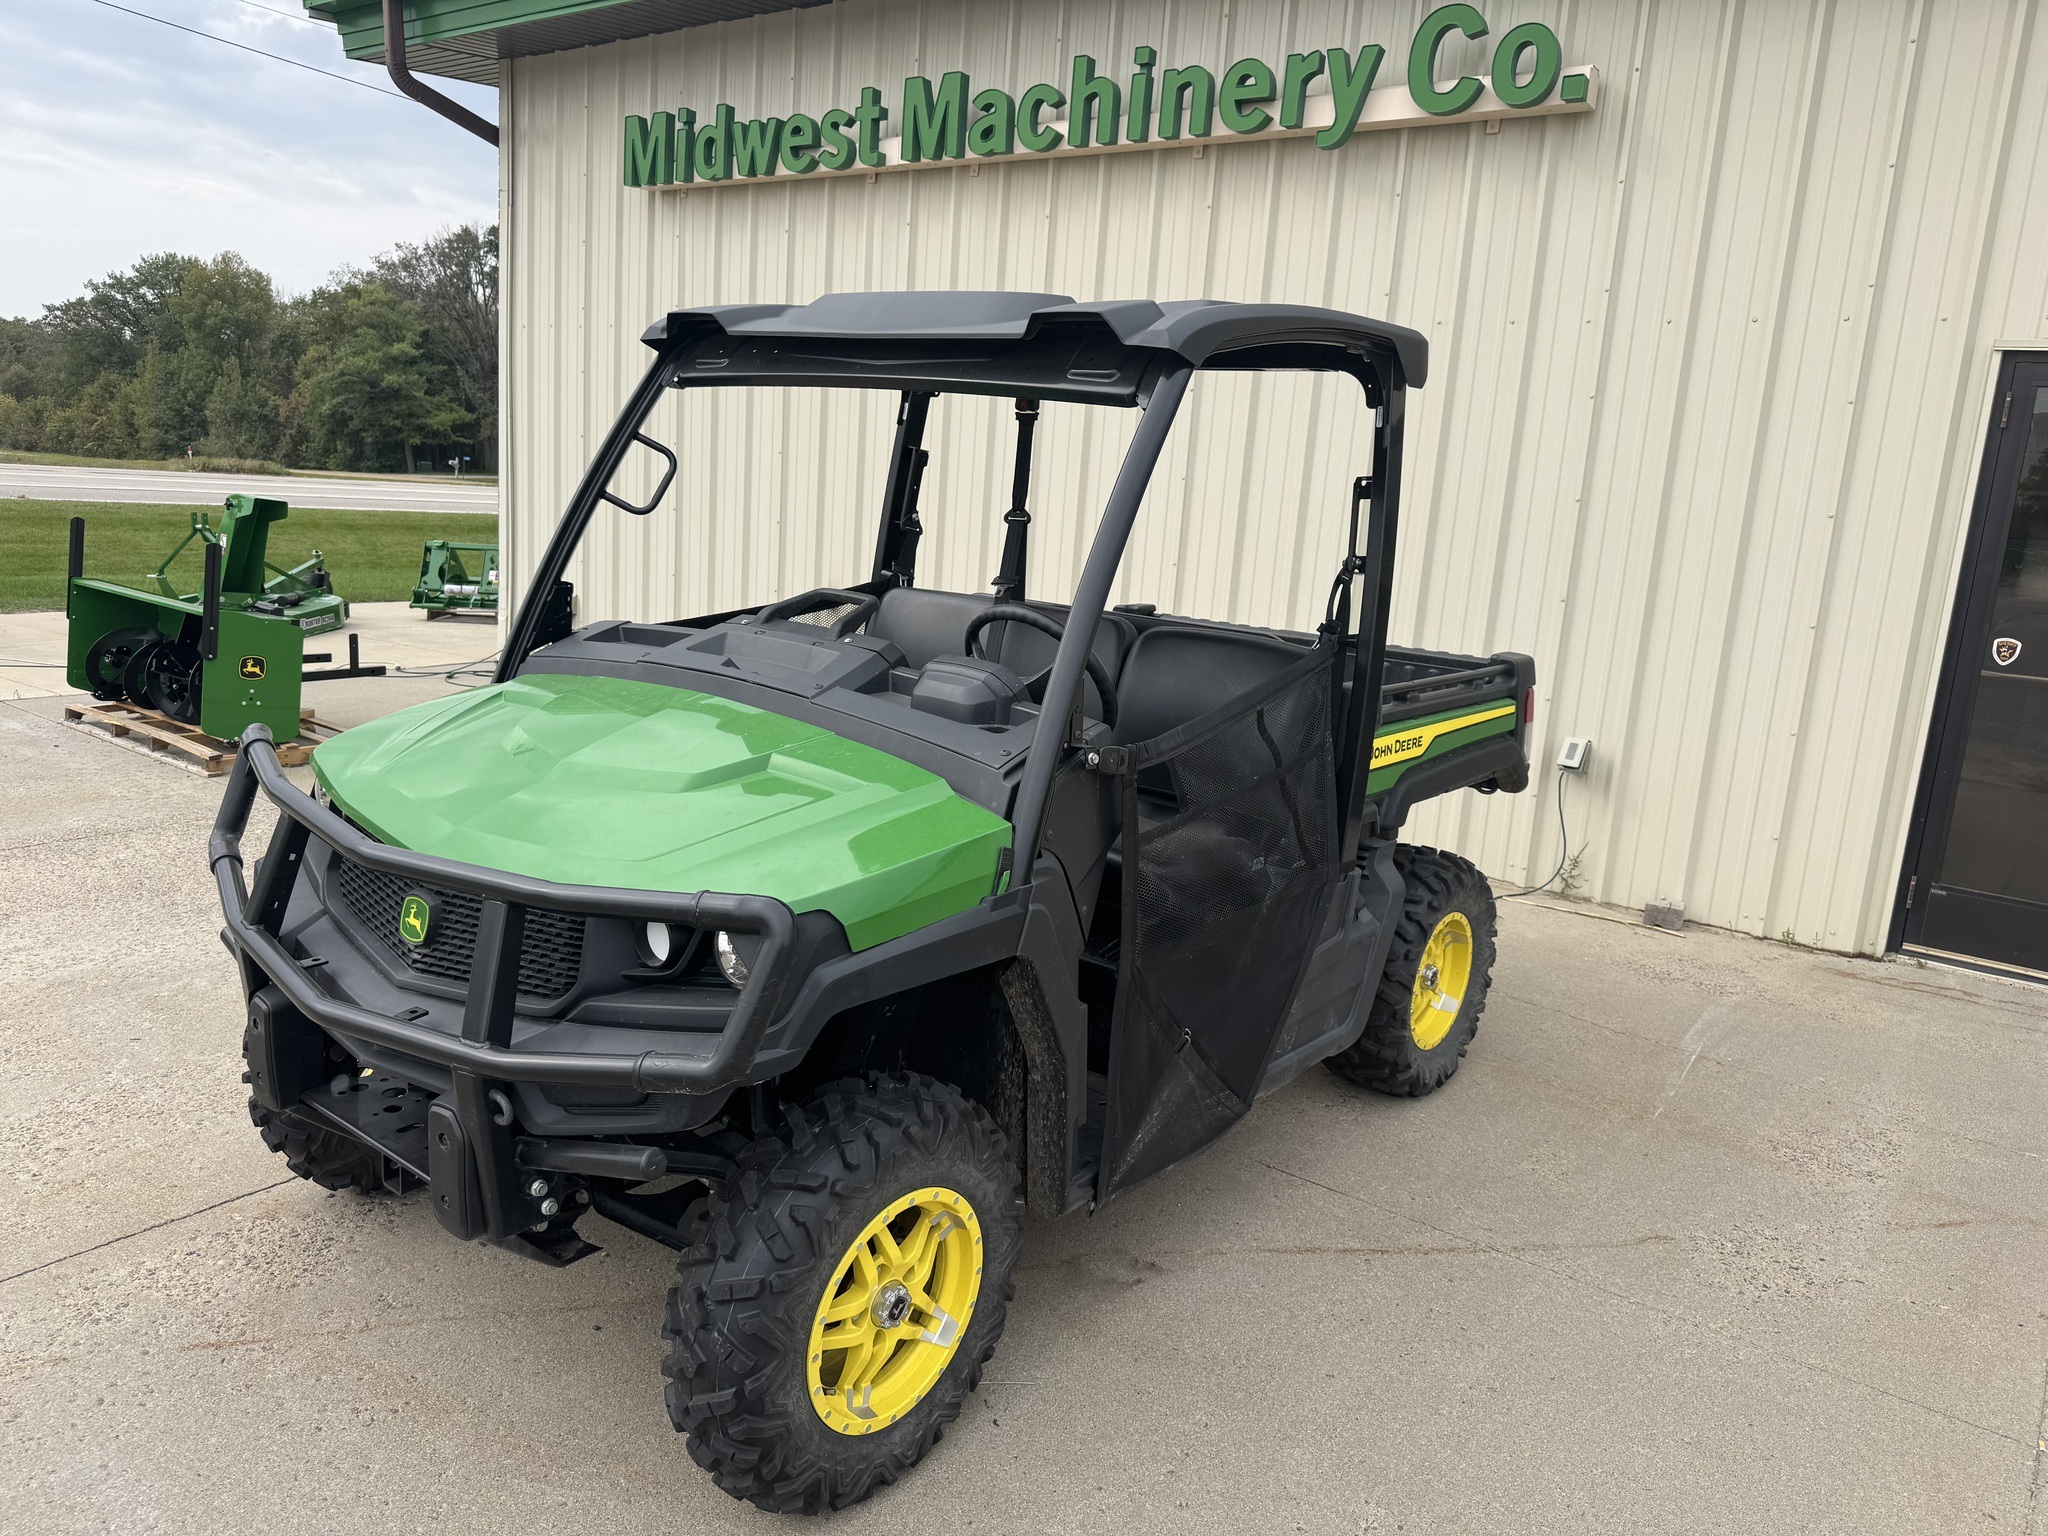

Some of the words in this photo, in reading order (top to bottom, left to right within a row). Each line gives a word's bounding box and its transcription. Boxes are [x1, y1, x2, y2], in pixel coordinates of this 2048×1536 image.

[624, 87, 888, 187] Midwest
[900, 44, 1386, 151] Machinery
[1407, 3, 1589, 116] Co.
[1394, 735, 1423, 754] DEERE
